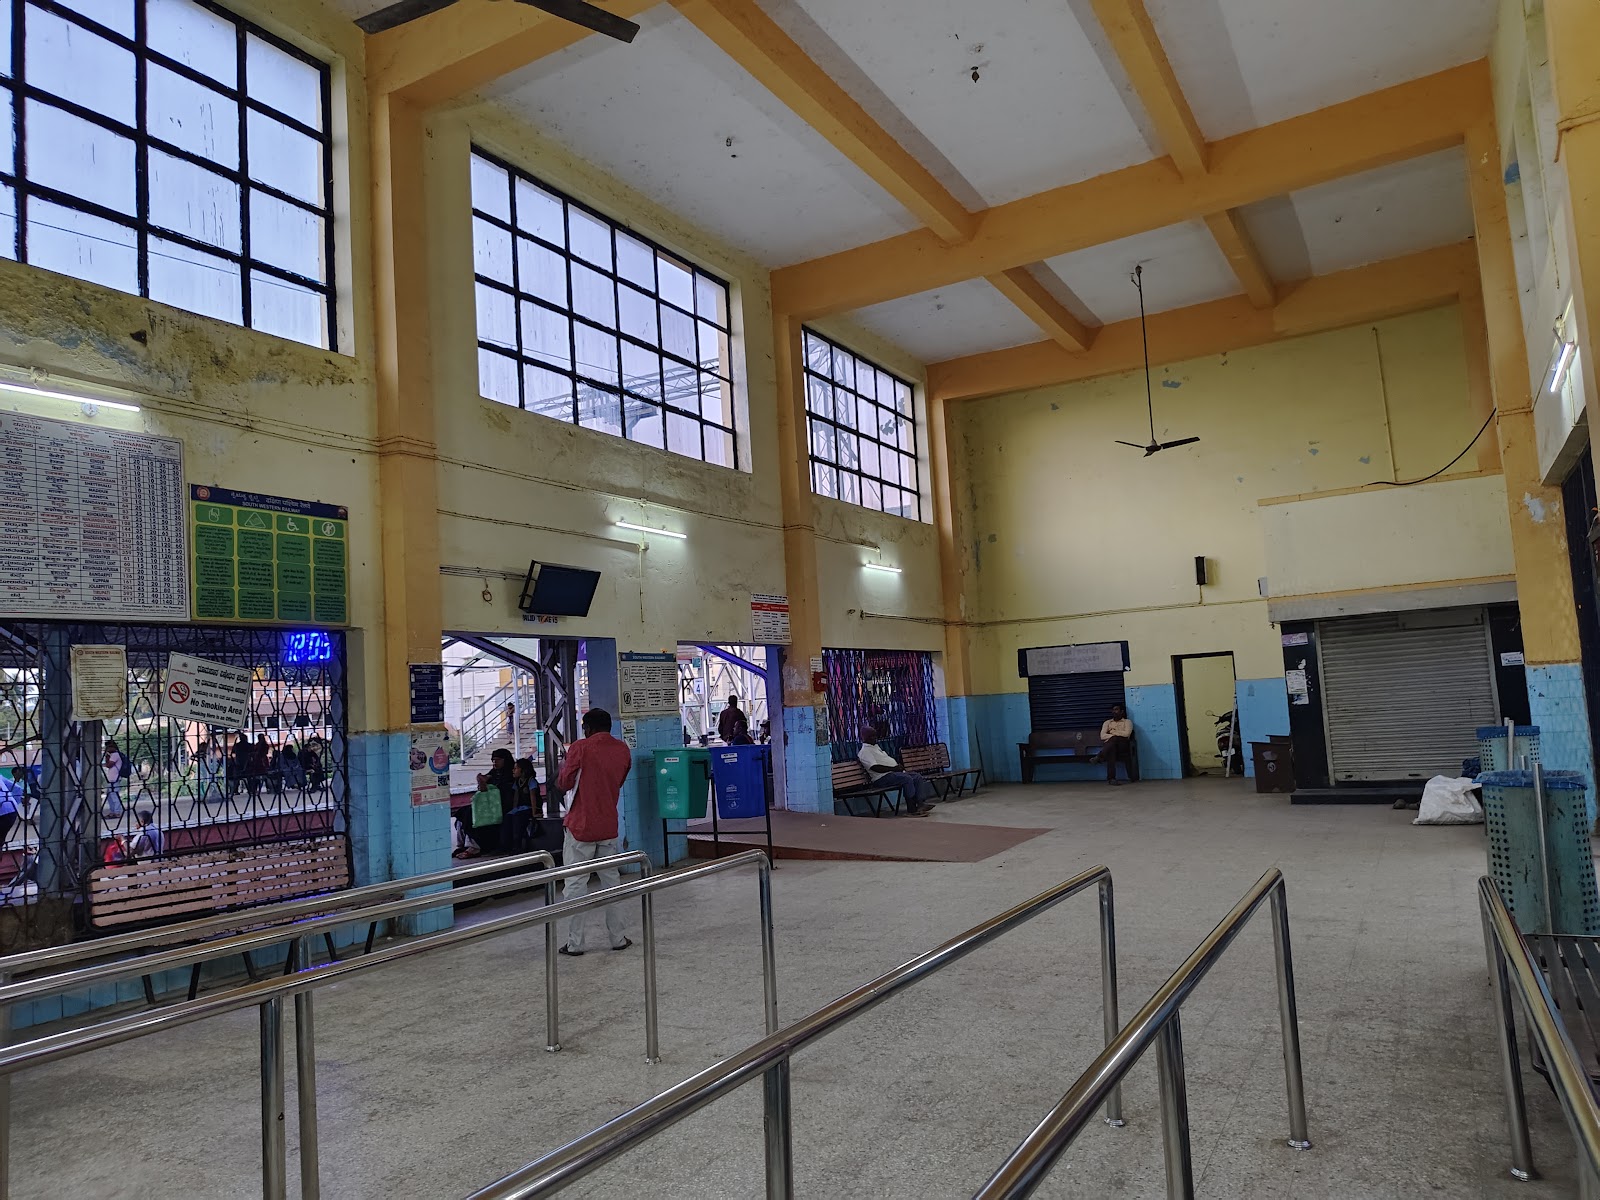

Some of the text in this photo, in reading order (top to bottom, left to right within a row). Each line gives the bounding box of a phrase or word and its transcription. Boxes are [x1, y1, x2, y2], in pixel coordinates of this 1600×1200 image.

[113, 440, 153, 449] CHANNAPATNA
[259, 503, 281, 511] WESTERN
[265, 497, 311, 510] दक्षिण पश्चिम रेलवे
[190, 697, 243, 715] No Smoking Area
[190, 709, 206, 718] Smoking
